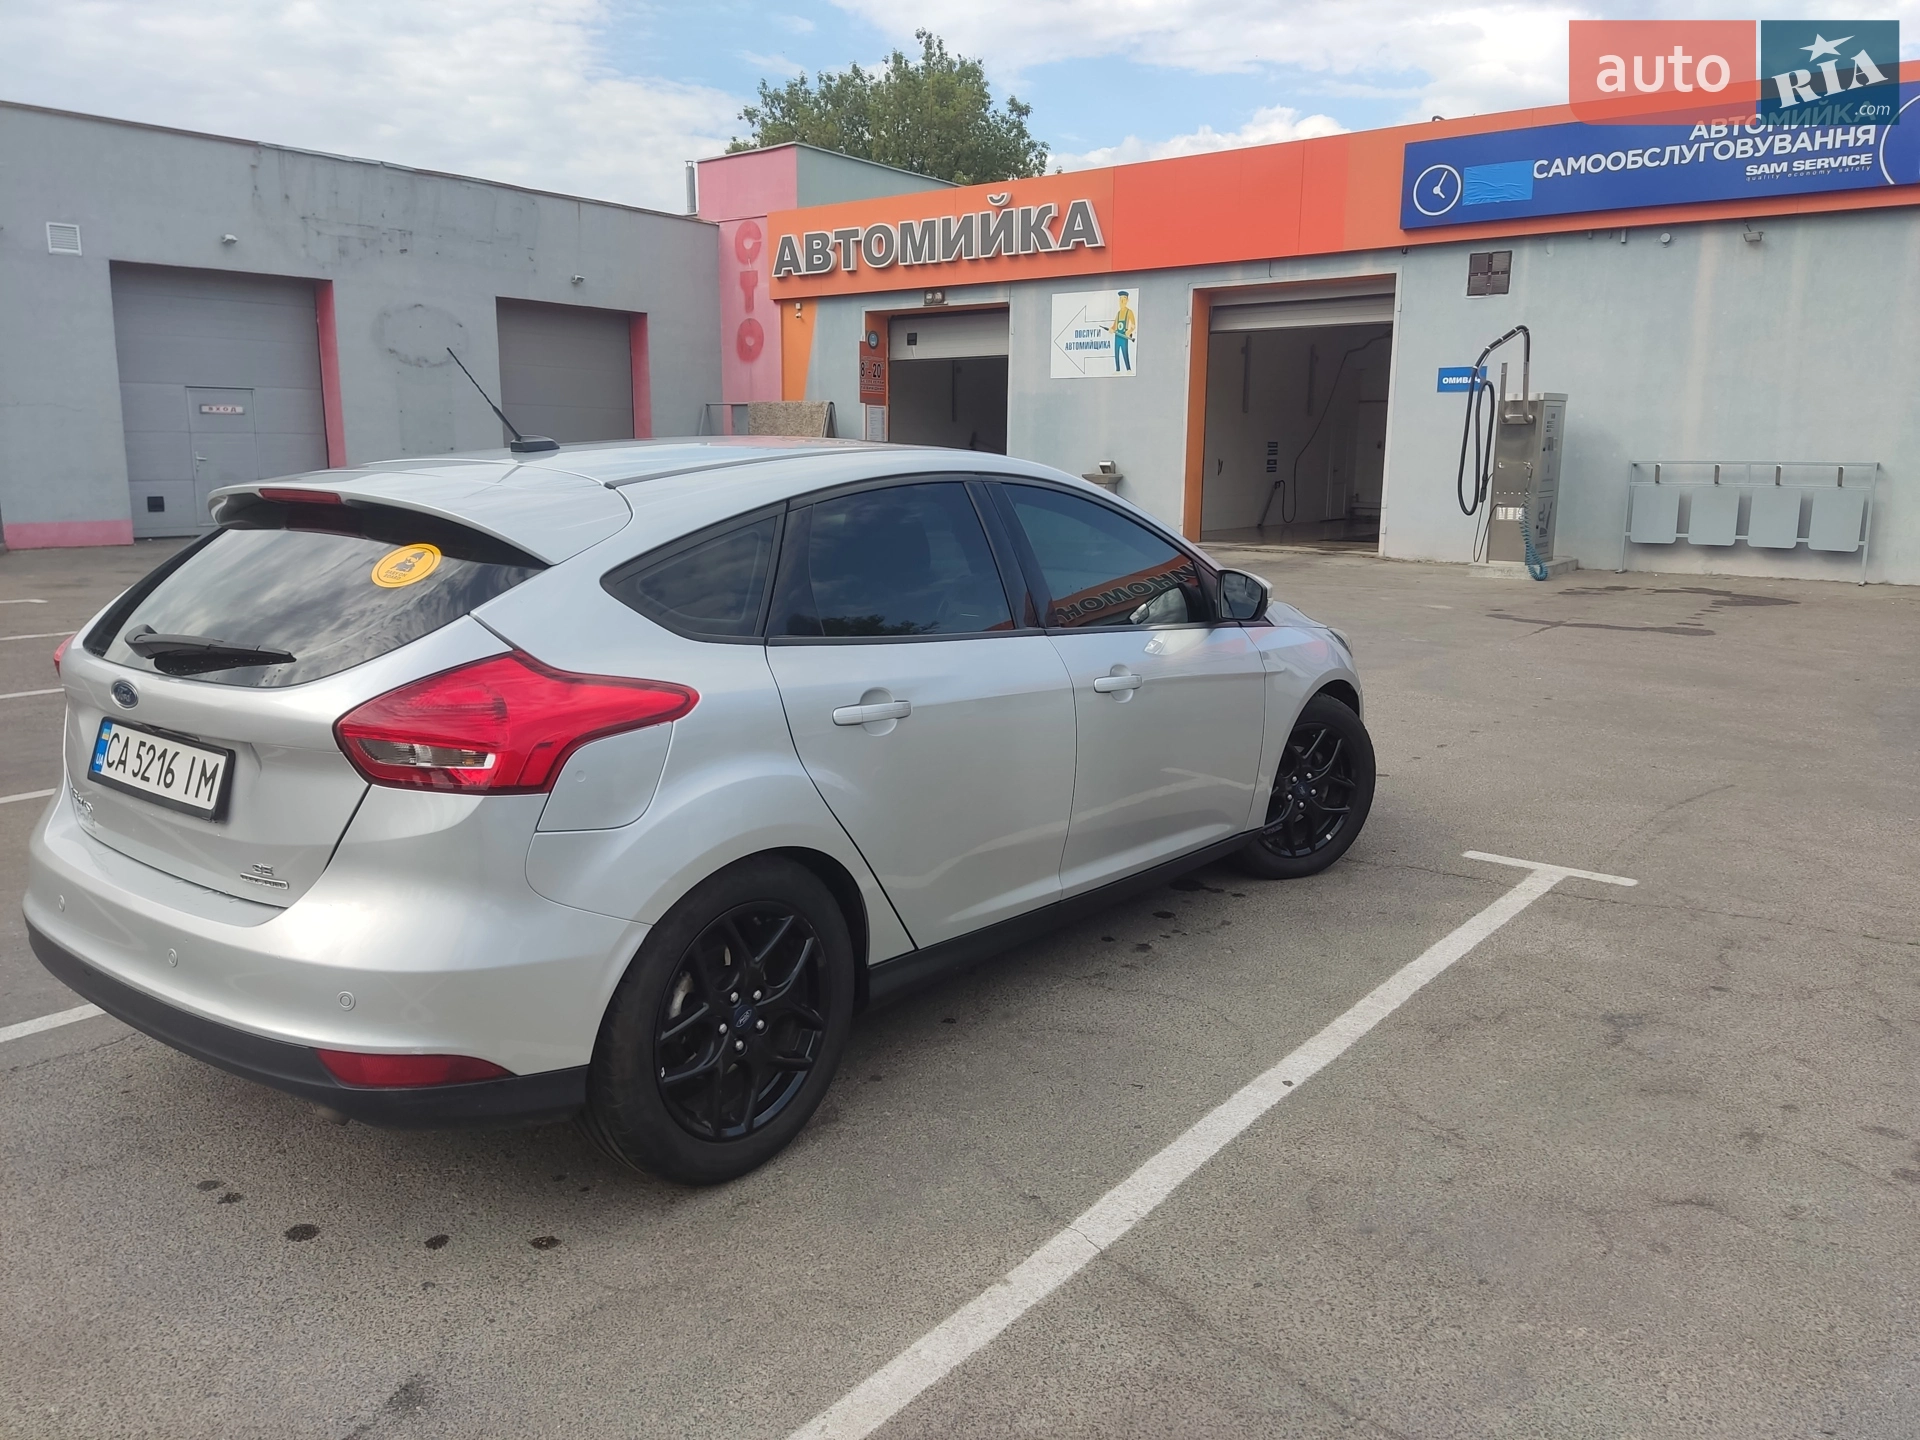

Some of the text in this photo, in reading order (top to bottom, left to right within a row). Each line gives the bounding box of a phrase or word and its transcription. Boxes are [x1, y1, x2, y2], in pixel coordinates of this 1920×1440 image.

[1689, 99, 1877, 141] АВТОМИЙКА
[1532, 124, 1876, 180] САМООБСЛУГОВУВАННЯ
[1745, 153, 1873, 177] SAM SERVICE
[771, 192, 1105, 279] АВТОМИЙКА
[1065, 340, 1111, 351] АВТОМИЙЩИКА
[1074, 328, 1101, 339] ПОСЛУГИ
[106, 732, 220, 802] CA 5216 IM
